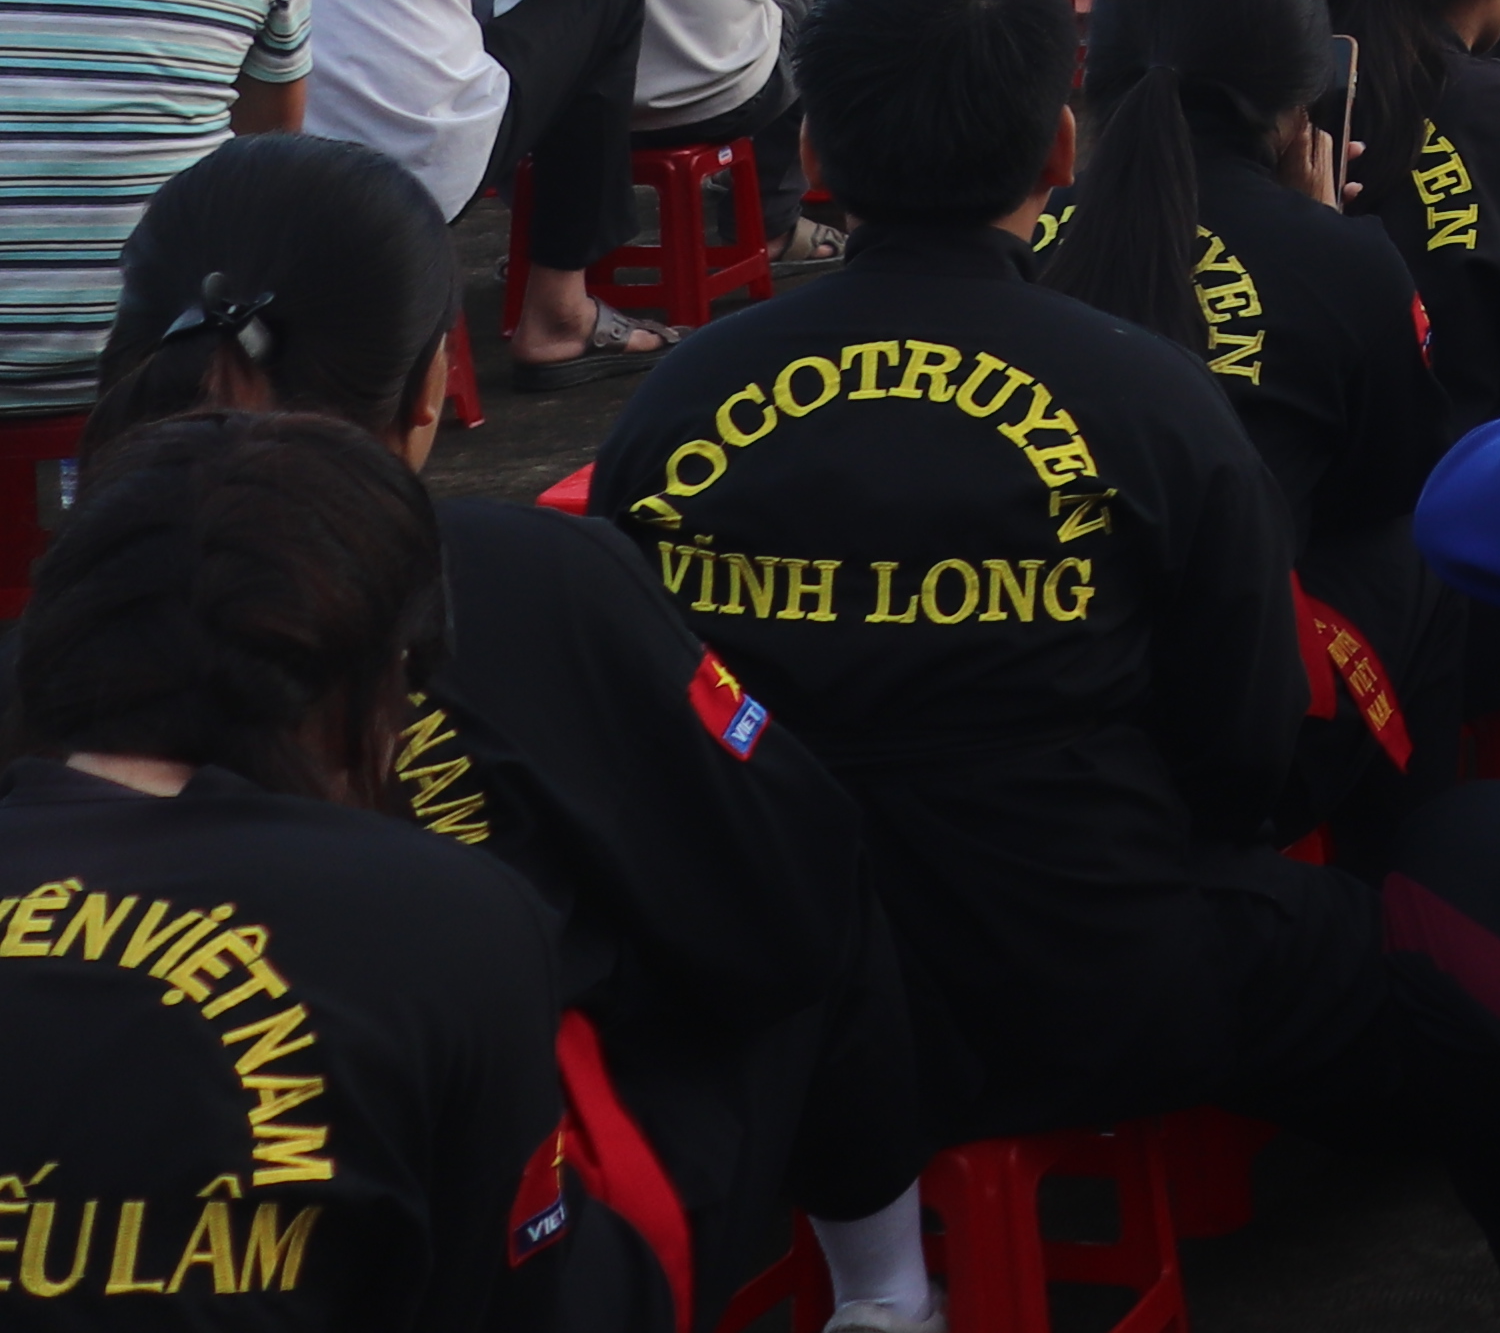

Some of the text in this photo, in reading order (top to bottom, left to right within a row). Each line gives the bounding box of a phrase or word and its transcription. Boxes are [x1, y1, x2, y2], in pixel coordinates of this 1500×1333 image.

[658, 534, 1096, 625] VĨNH LONG
[395, 708, 491, 846] NAM
[220, 1002, 335, 1187] NAM
[104, 1173, 323, 1296] LÂM
